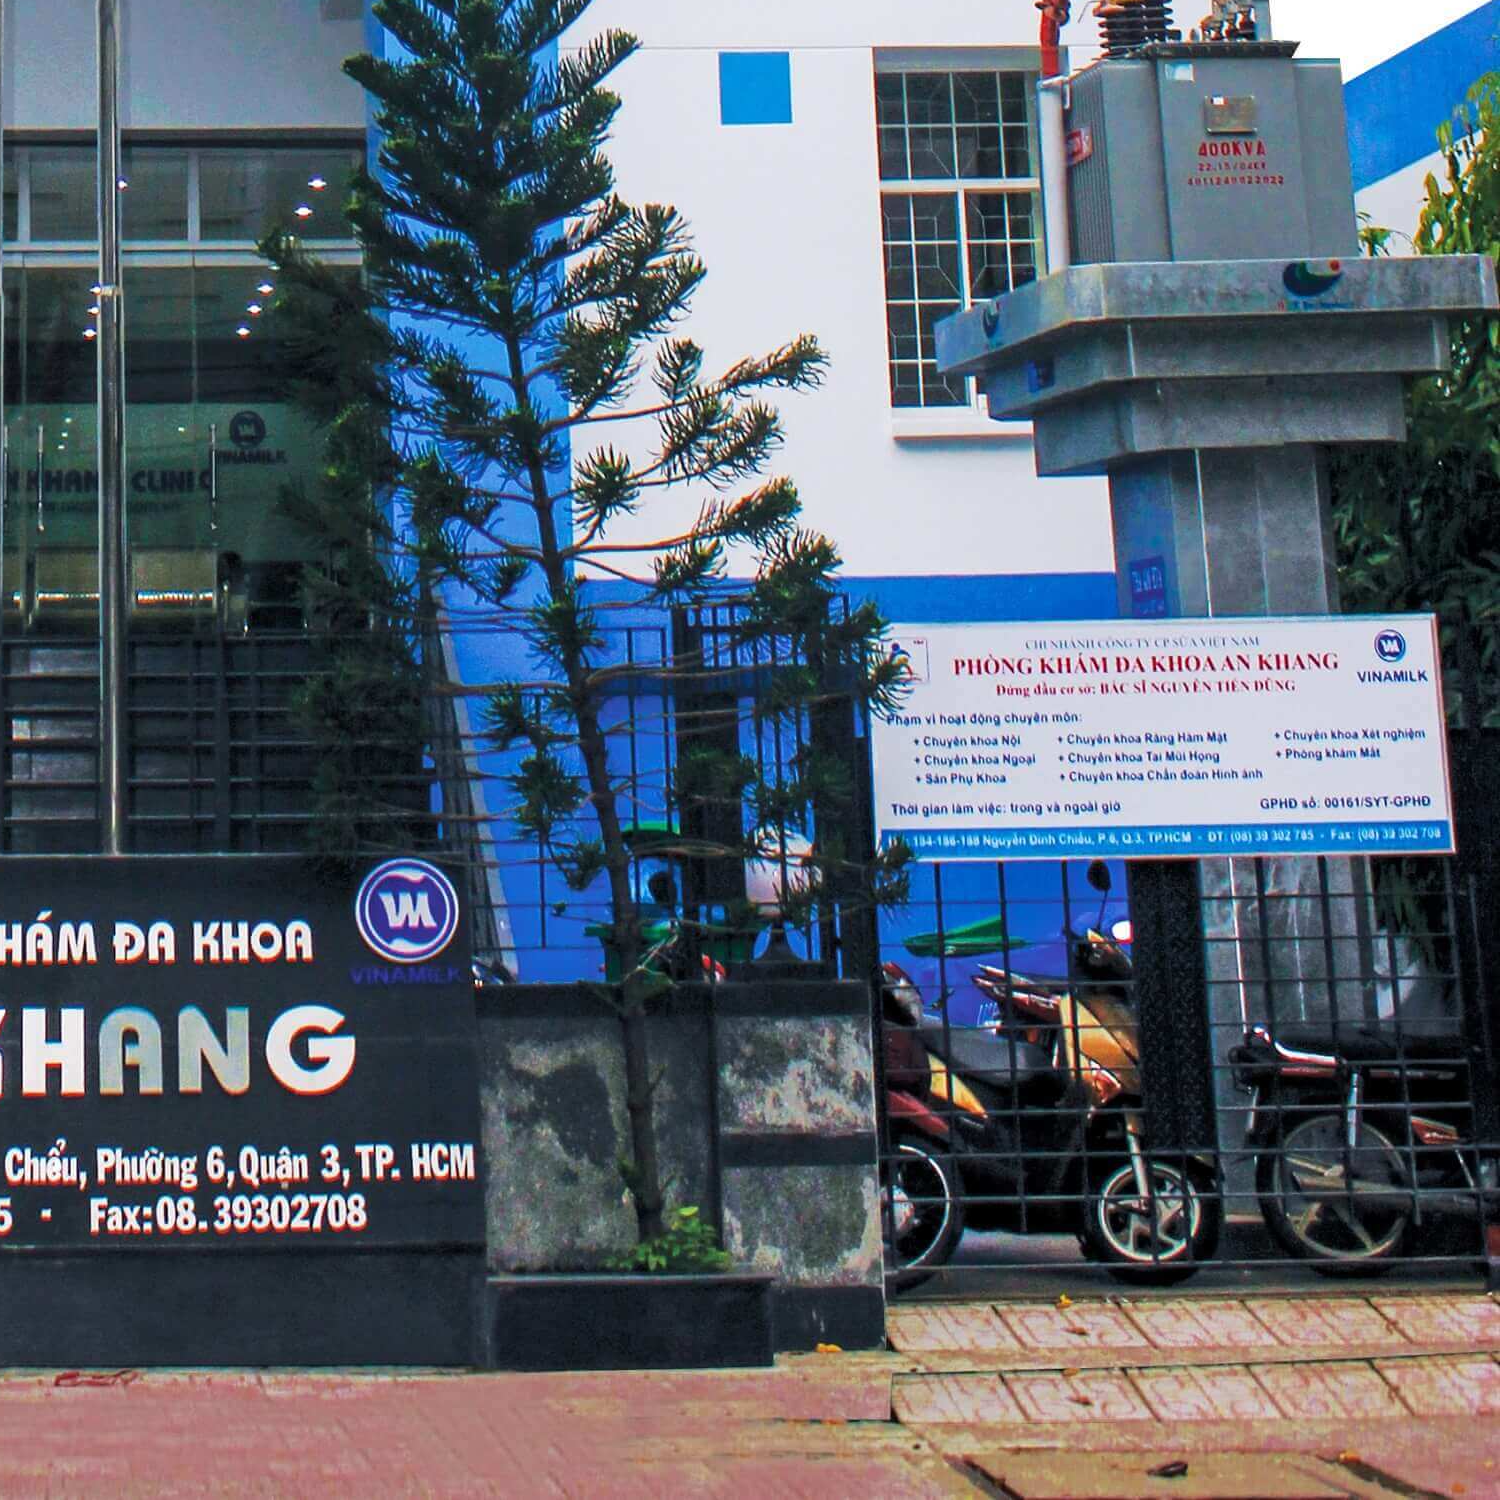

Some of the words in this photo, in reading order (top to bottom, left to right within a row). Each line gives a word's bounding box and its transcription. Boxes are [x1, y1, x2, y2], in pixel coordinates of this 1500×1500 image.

[1197, 140, 1267, 157] 400KVA
[953, 652, 1033, 676] PHÒNG
[1040, 651, 1109, 675] KHÁM
[1115, 655, 1146, 674] ĐA
[1151, 655, 1217, 673] KHOA
[1221, 654, 1250, 672] AN
[1257, 652, 1340, 671] KHANG
[1357, 669, 1429, 684] VINAMILK
[926, 714, 936, 725] vi
[970, 713, 1001, 727] động
[1005, 712, 1048, 725] chuyên
[923, 735, 968, 748] Chuyên
[970, 735, 998, 746] khoa
[1002, 734, 1021, 747] Nội
[1068, 734, 1111, 747] Chuyên
[1114, 733, 1142, 744] khoa
[1284, 729, 1327, 742] Chuyên
[1331, 729, 1358, 740] khoa
[924, 754, 968, 767] Chuyên
[971, 754, 999, 765] khoa
[1003, 753, 1036, 766] Ngoại
[1068, 752, 1112, 766] Chuyên
[1115, 752, 1143, 763] khoa
[1147, 751, 1163, 762] Tai
[1189, 750, 1220, 764] Họng
[976, 772, 1007, 783] Khoa
[1069, 770, 1113, 784] Chuyên
[1116, 770, 1144, 781] khoa
[922, 803, 948, 817] gian
[1010, 802, 1043, 816] trong
[113, 920, 176, 964] ĐA
[192, 919, 314, 964] KHOA
[350, 966, 462, 984] VINAMILK
[4, 1138, 87, 1191] Chiểu,
[96, 1146, 198, 1191] Phường
[238, 1144, 309, 1190] Quận
[320, 1143, 350, 1188] 3,
[354, 1143, 401, 1181] TP.
[411, 1143, 476, 1182] HCM
[90, 1197, 153, 1235] Fax:
[212, 1194, 368, 1235] 39302708
